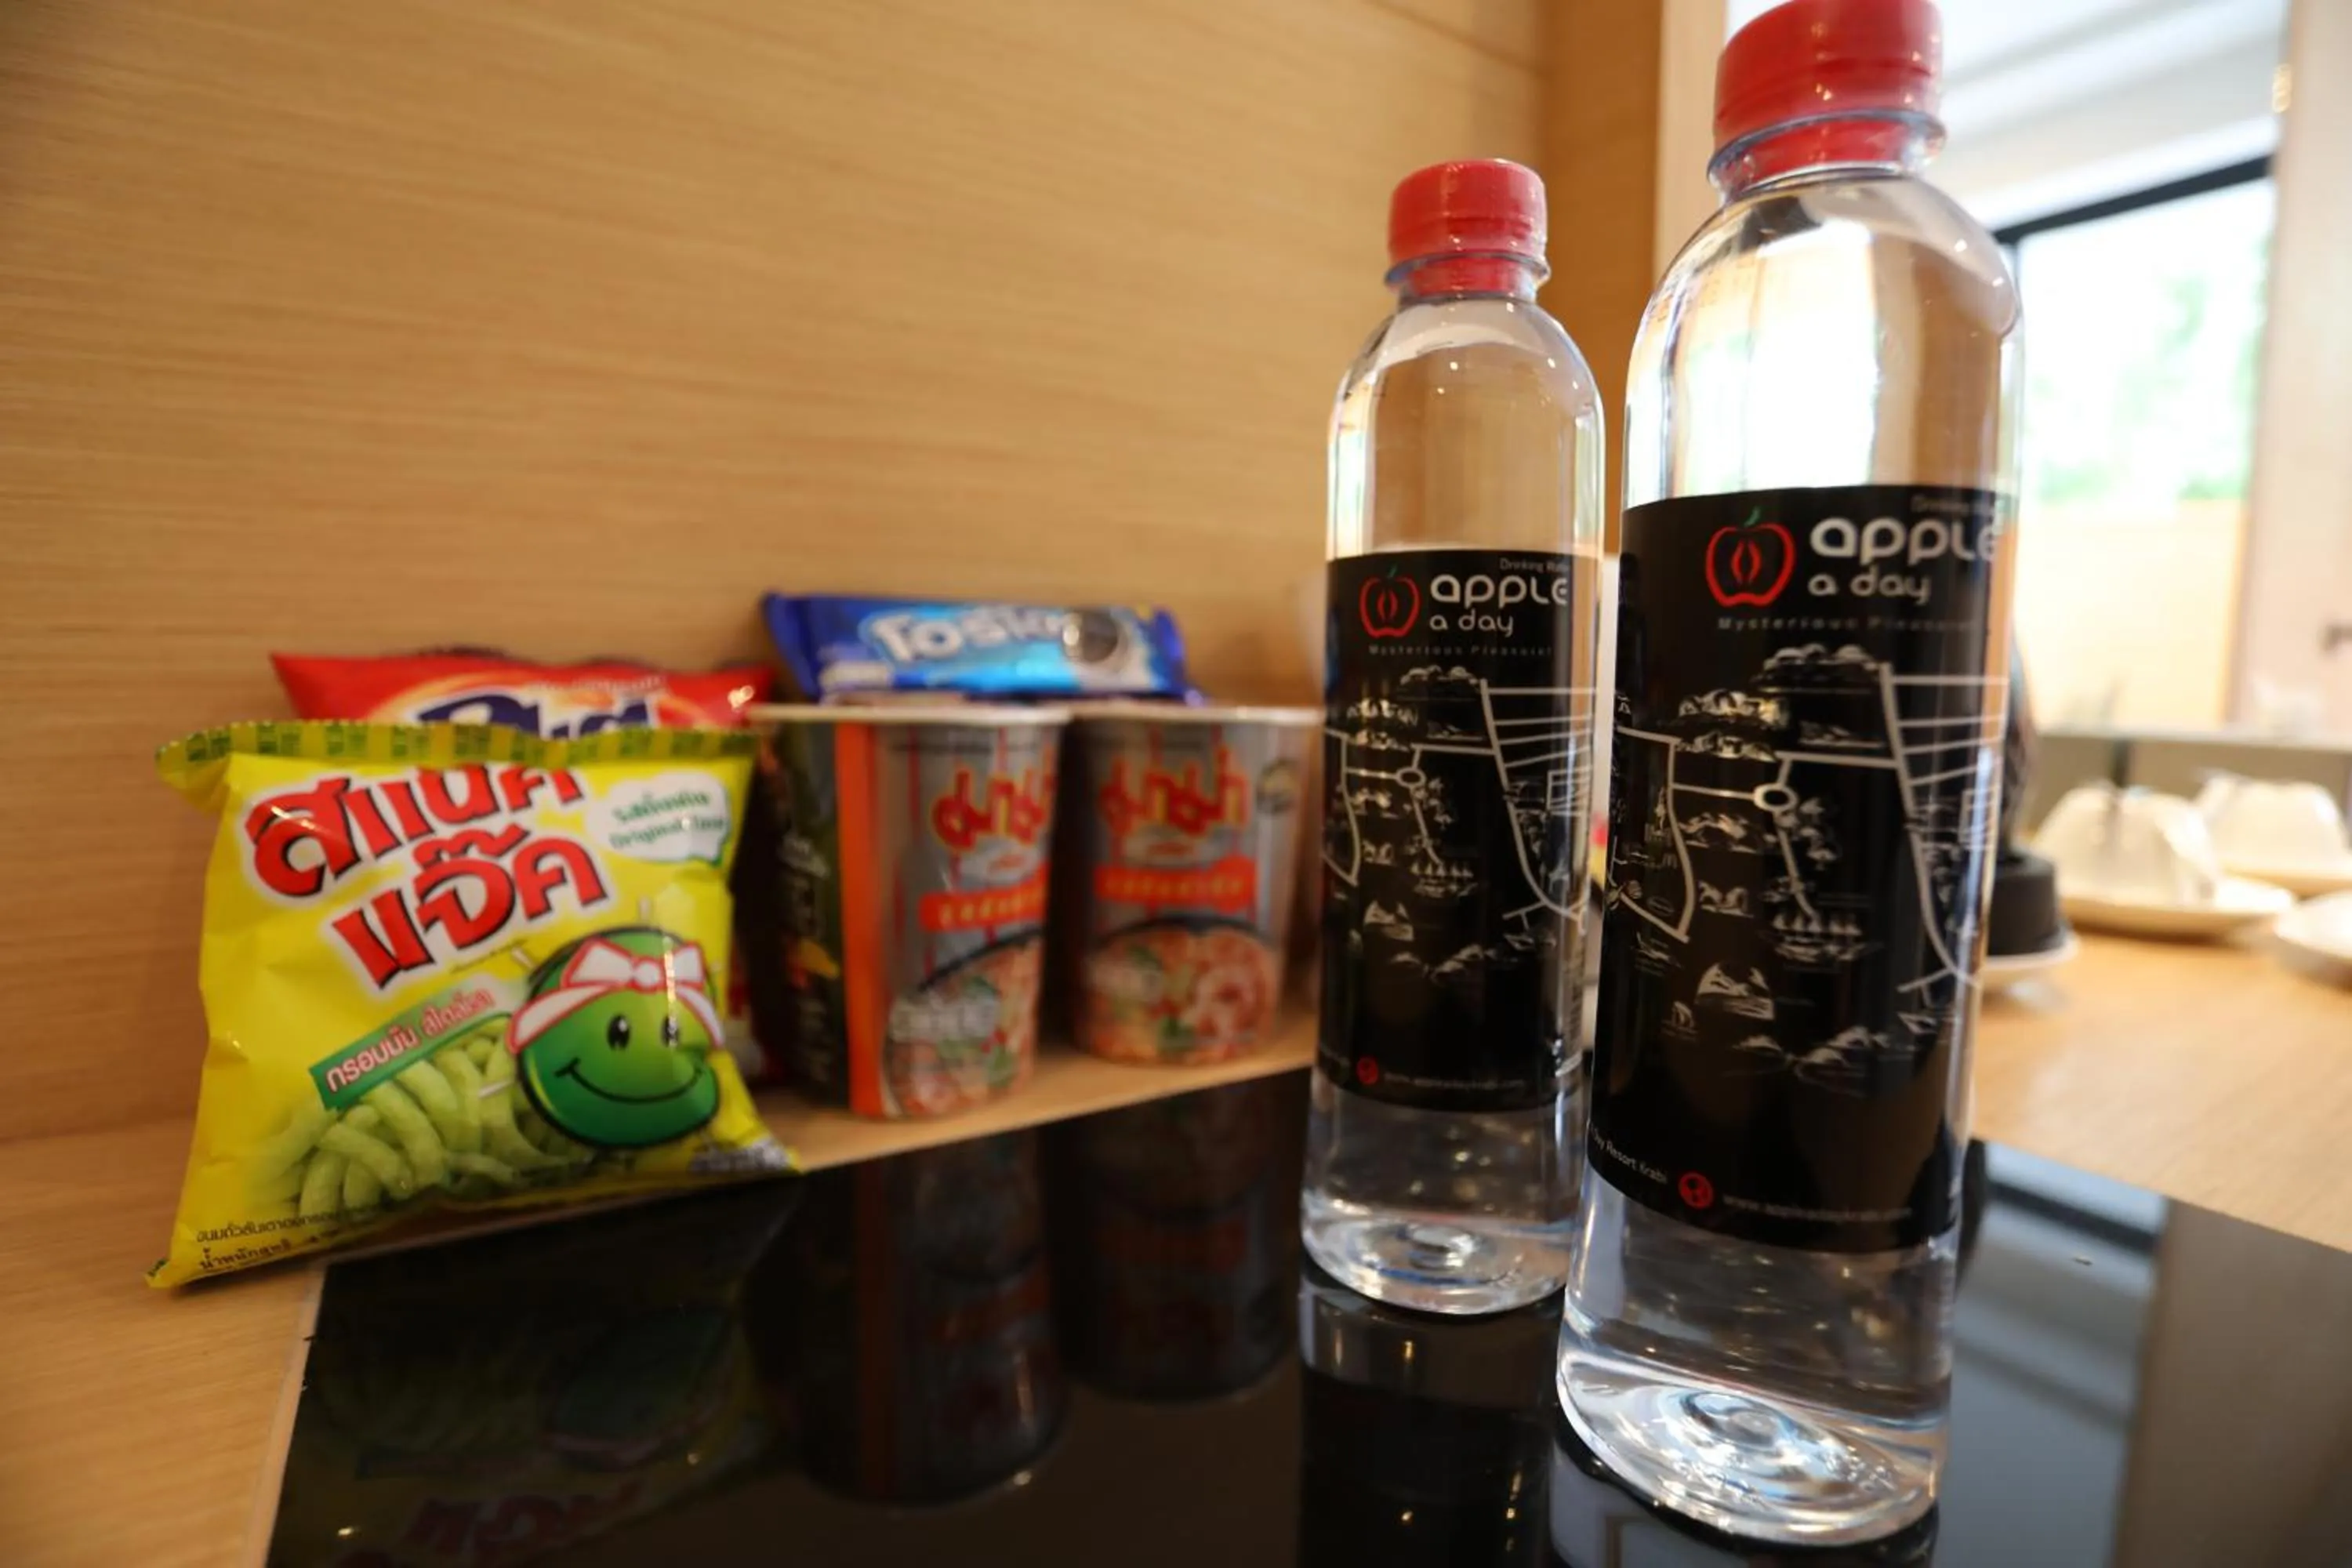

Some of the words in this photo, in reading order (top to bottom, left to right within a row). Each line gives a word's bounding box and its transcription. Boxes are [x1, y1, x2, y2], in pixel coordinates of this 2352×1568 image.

[1430, 574, 1569, 608] apple
[1809, 574, 1837, 596] a
[1851, 566, 1931, 604] day
[1429, 614, 1448, 630] a
[1457, 608, 1515, 637] day
